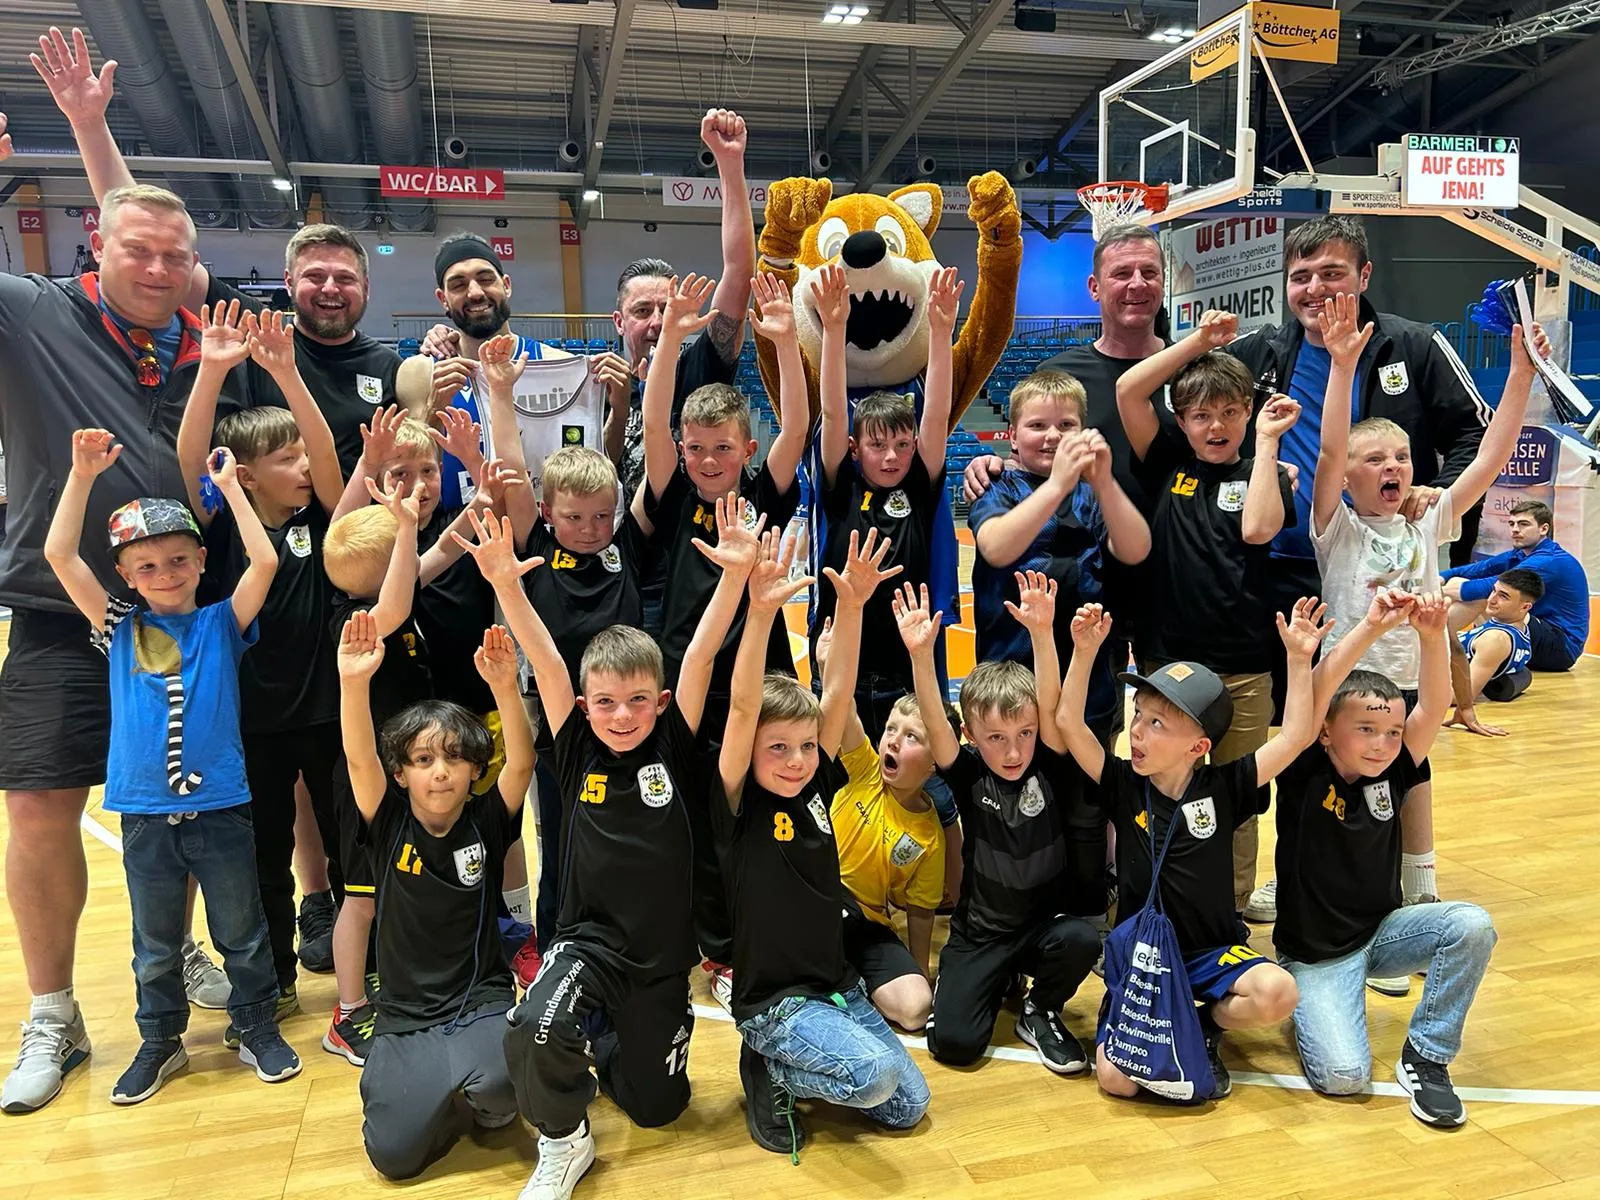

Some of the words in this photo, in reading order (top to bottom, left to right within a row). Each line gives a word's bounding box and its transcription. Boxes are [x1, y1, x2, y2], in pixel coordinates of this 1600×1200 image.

[1262, 22, 1317, 38] Böttcher
[1319, 28, 1338, 40] AG
[1421, 156, 1453, 175] AUF
[1456, 157, 1505, 177] GEHTS
[387, 172, 478, 195] WC/BAR
[1441, 180, 1485, 200] JENA!
[1238, 198, 1283, 209] Sports
[1352, 193, 1398, 201] SPORTSERVICE
[21, 216, 41, 229] E2
[562, 229, 578, 241] E3
[1516, 228, 1545, 248] Sports
[494, 242, 513, 256] A5
[1195, 254, 1231, 271] architekten
[1240, 243, 1277, 261] ingenieure
[1195, 259, 1276, 285] www.wettig-plus.de
[993, 431, 1005, 440] A7
[1171, 472, 1199, 497] 12
[860, 490, 874, 511] 1
[773, 811, 795, 842] 8
[1217, 944, 1264, 967] 10
